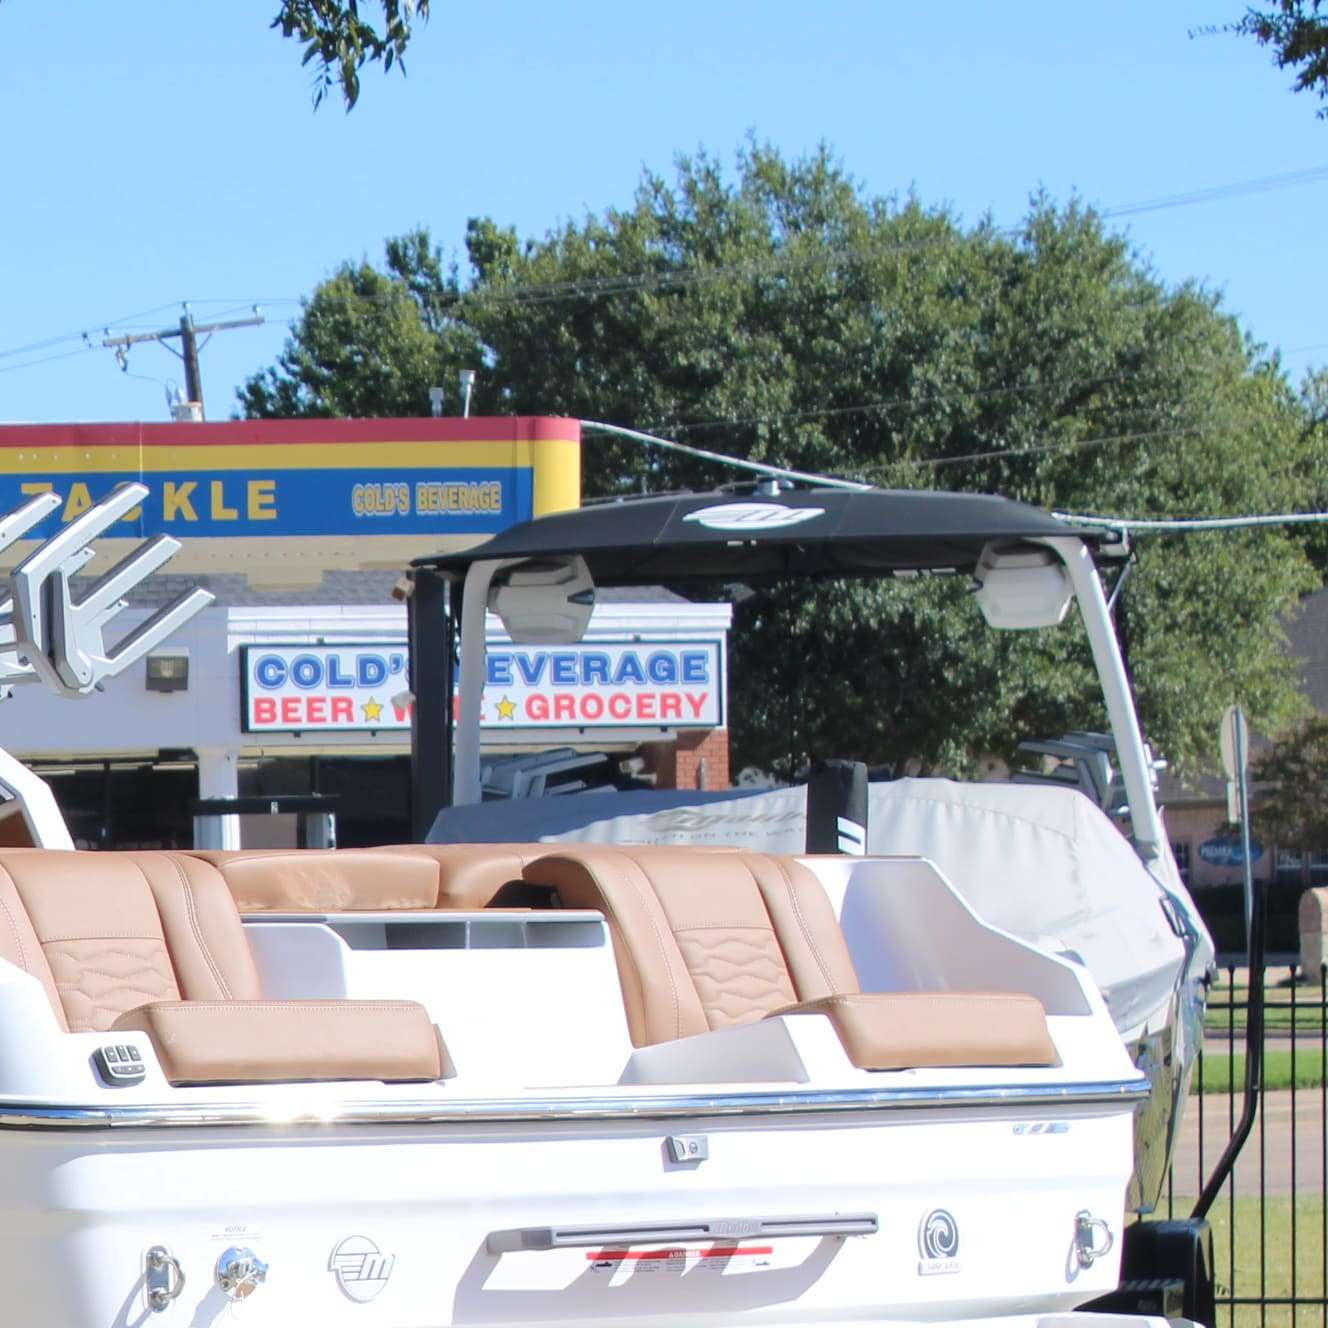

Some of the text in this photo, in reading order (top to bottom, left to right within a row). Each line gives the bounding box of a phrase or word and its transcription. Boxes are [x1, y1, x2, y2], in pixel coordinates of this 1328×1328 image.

[352, 481, 502, 517] COLD'S BEVERAGE
[253, 649, 711, 690] COLD' EVERAGE
[254, 691, 710, 724] BEER GROCERY
